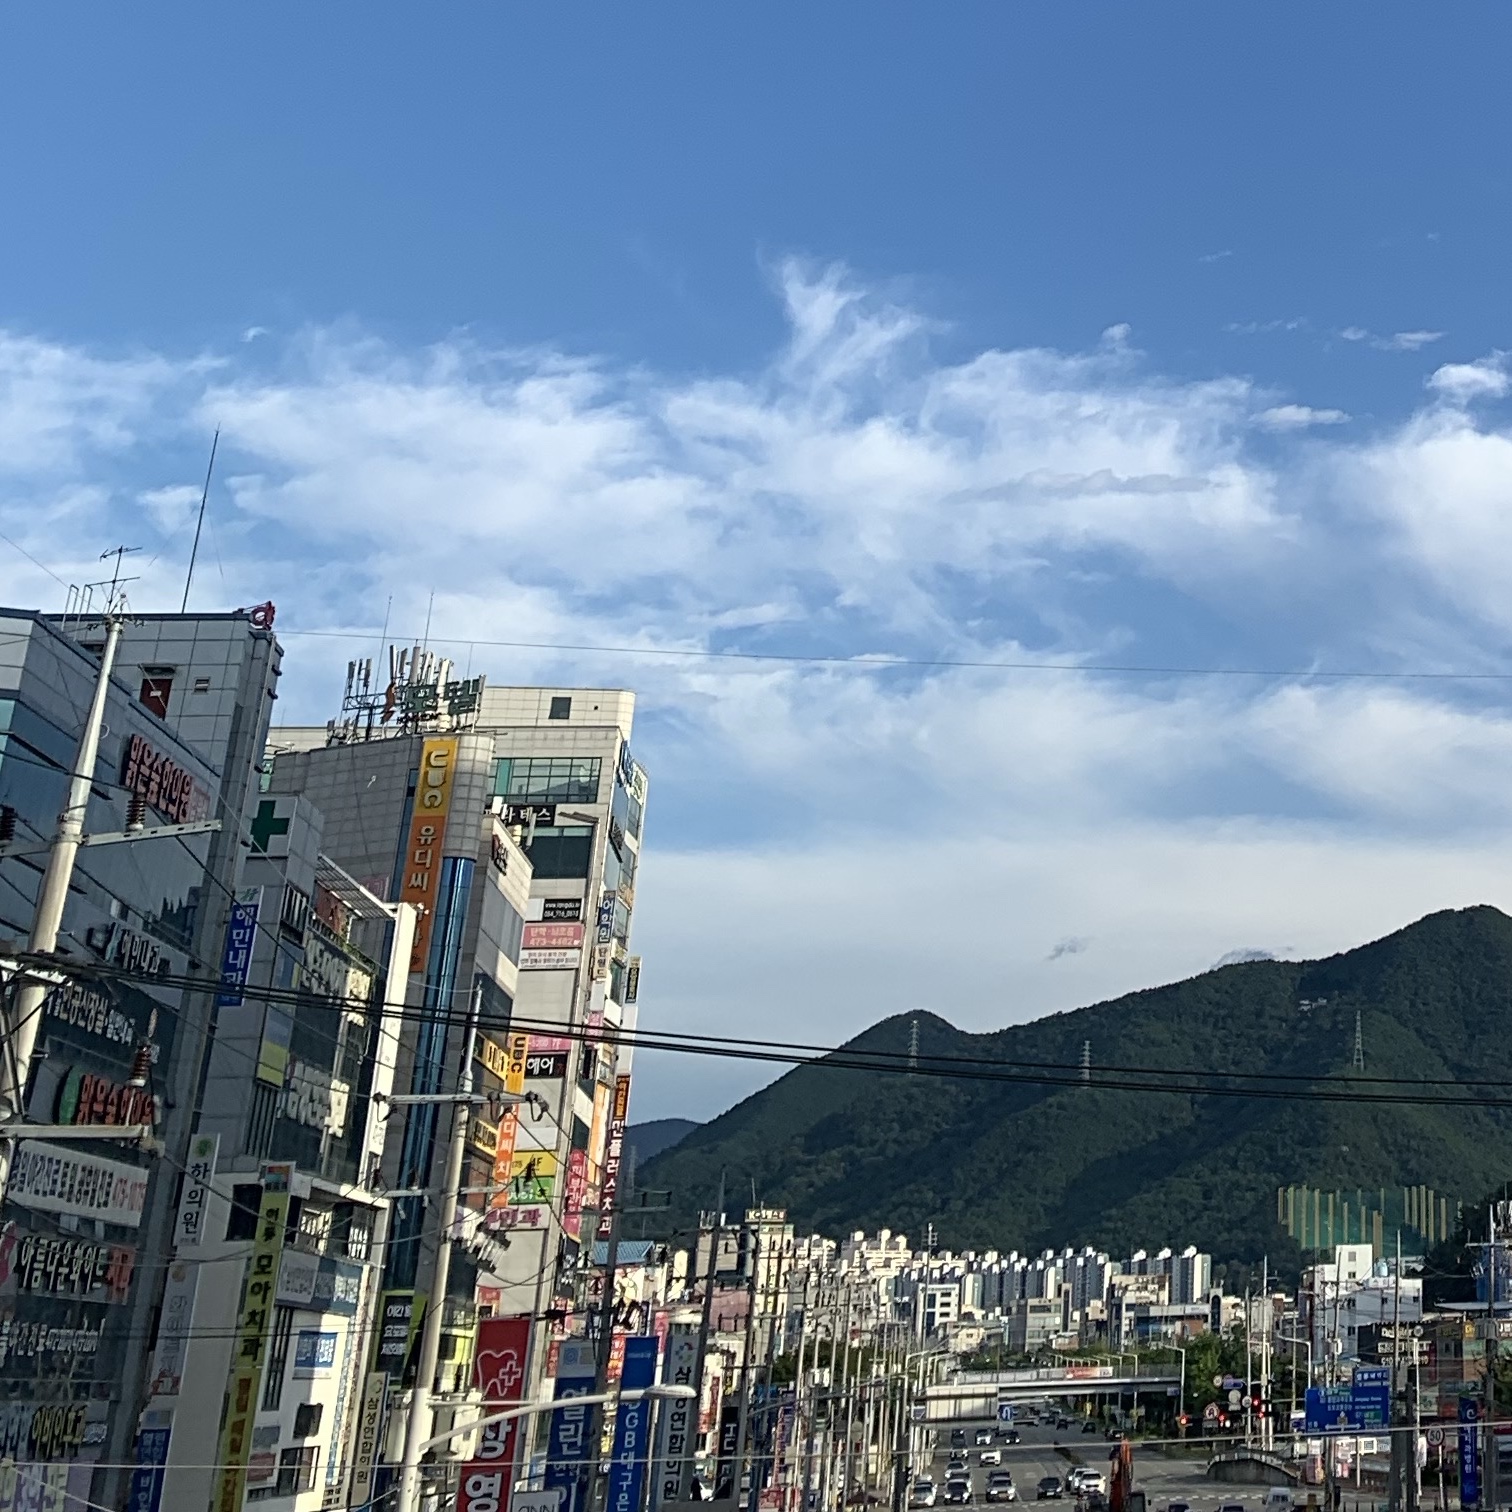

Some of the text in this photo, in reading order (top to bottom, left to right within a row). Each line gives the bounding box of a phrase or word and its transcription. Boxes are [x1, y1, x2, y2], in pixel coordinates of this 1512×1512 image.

[182, 1162, 211, 1235] 한의원
[240, 1254, 272, 1362] 모아치과
[1430, 1429, 1440, 1442] 50
